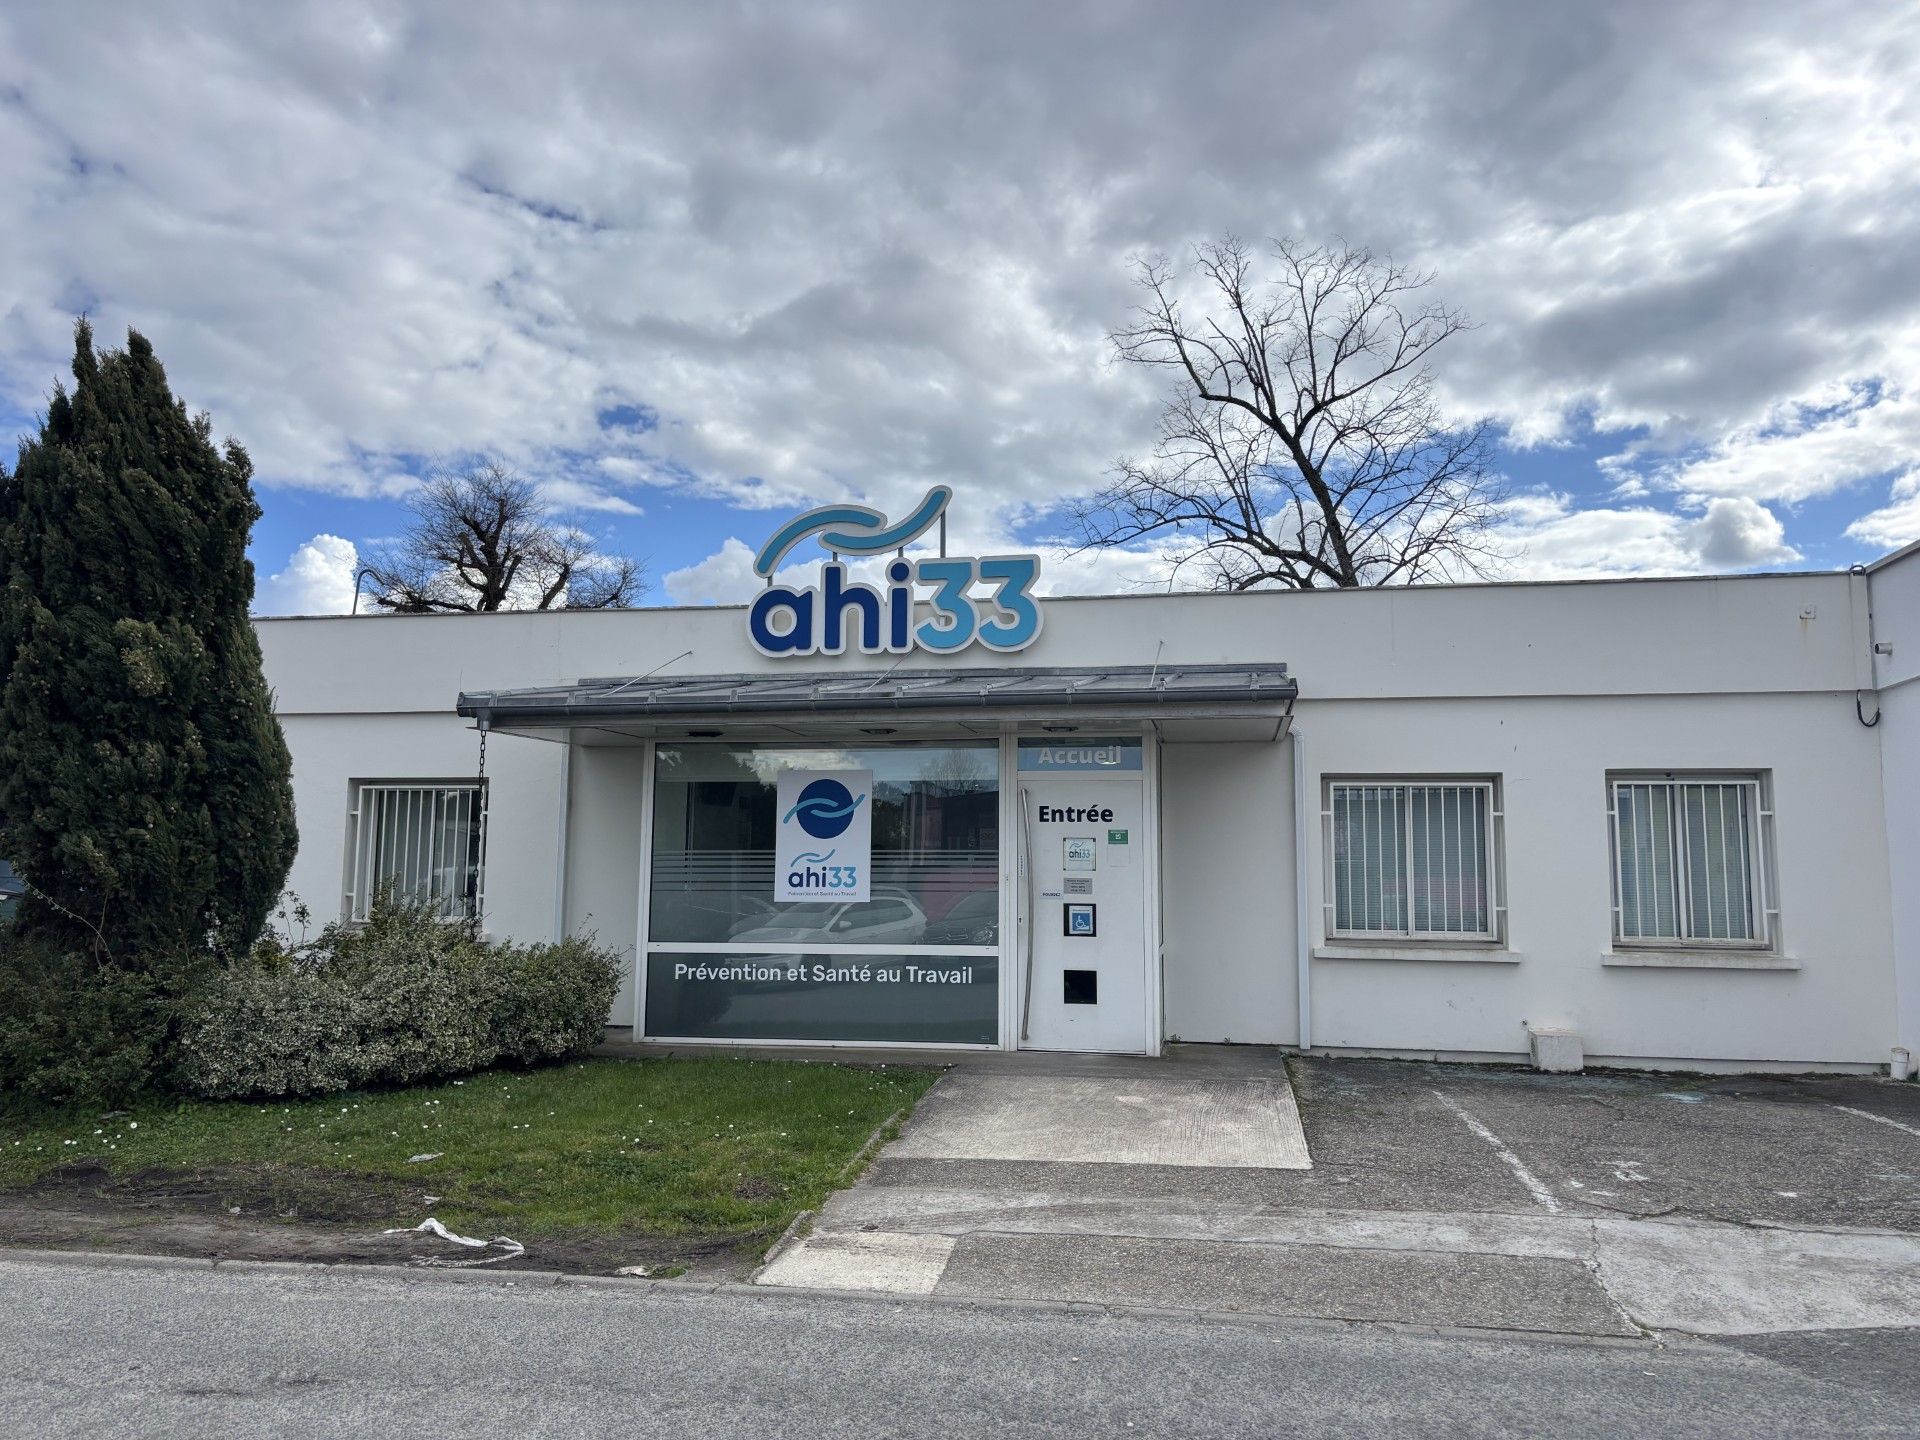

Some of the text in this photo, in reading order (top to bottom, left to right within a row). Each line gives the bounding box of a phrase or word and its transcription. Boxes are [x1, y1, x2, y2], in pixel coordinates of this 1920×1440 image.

[750, 558, 1038, 651] ahi33
[1039, 745, 1121, 765] Accueil
[1039, 804, 1113, 823] Entrée
[1068, 848, 1091, 859] ahi33
[788, 866, 857, 888] ahi33
[674, 963, 972, 984] Prévention et Santé au Travail
